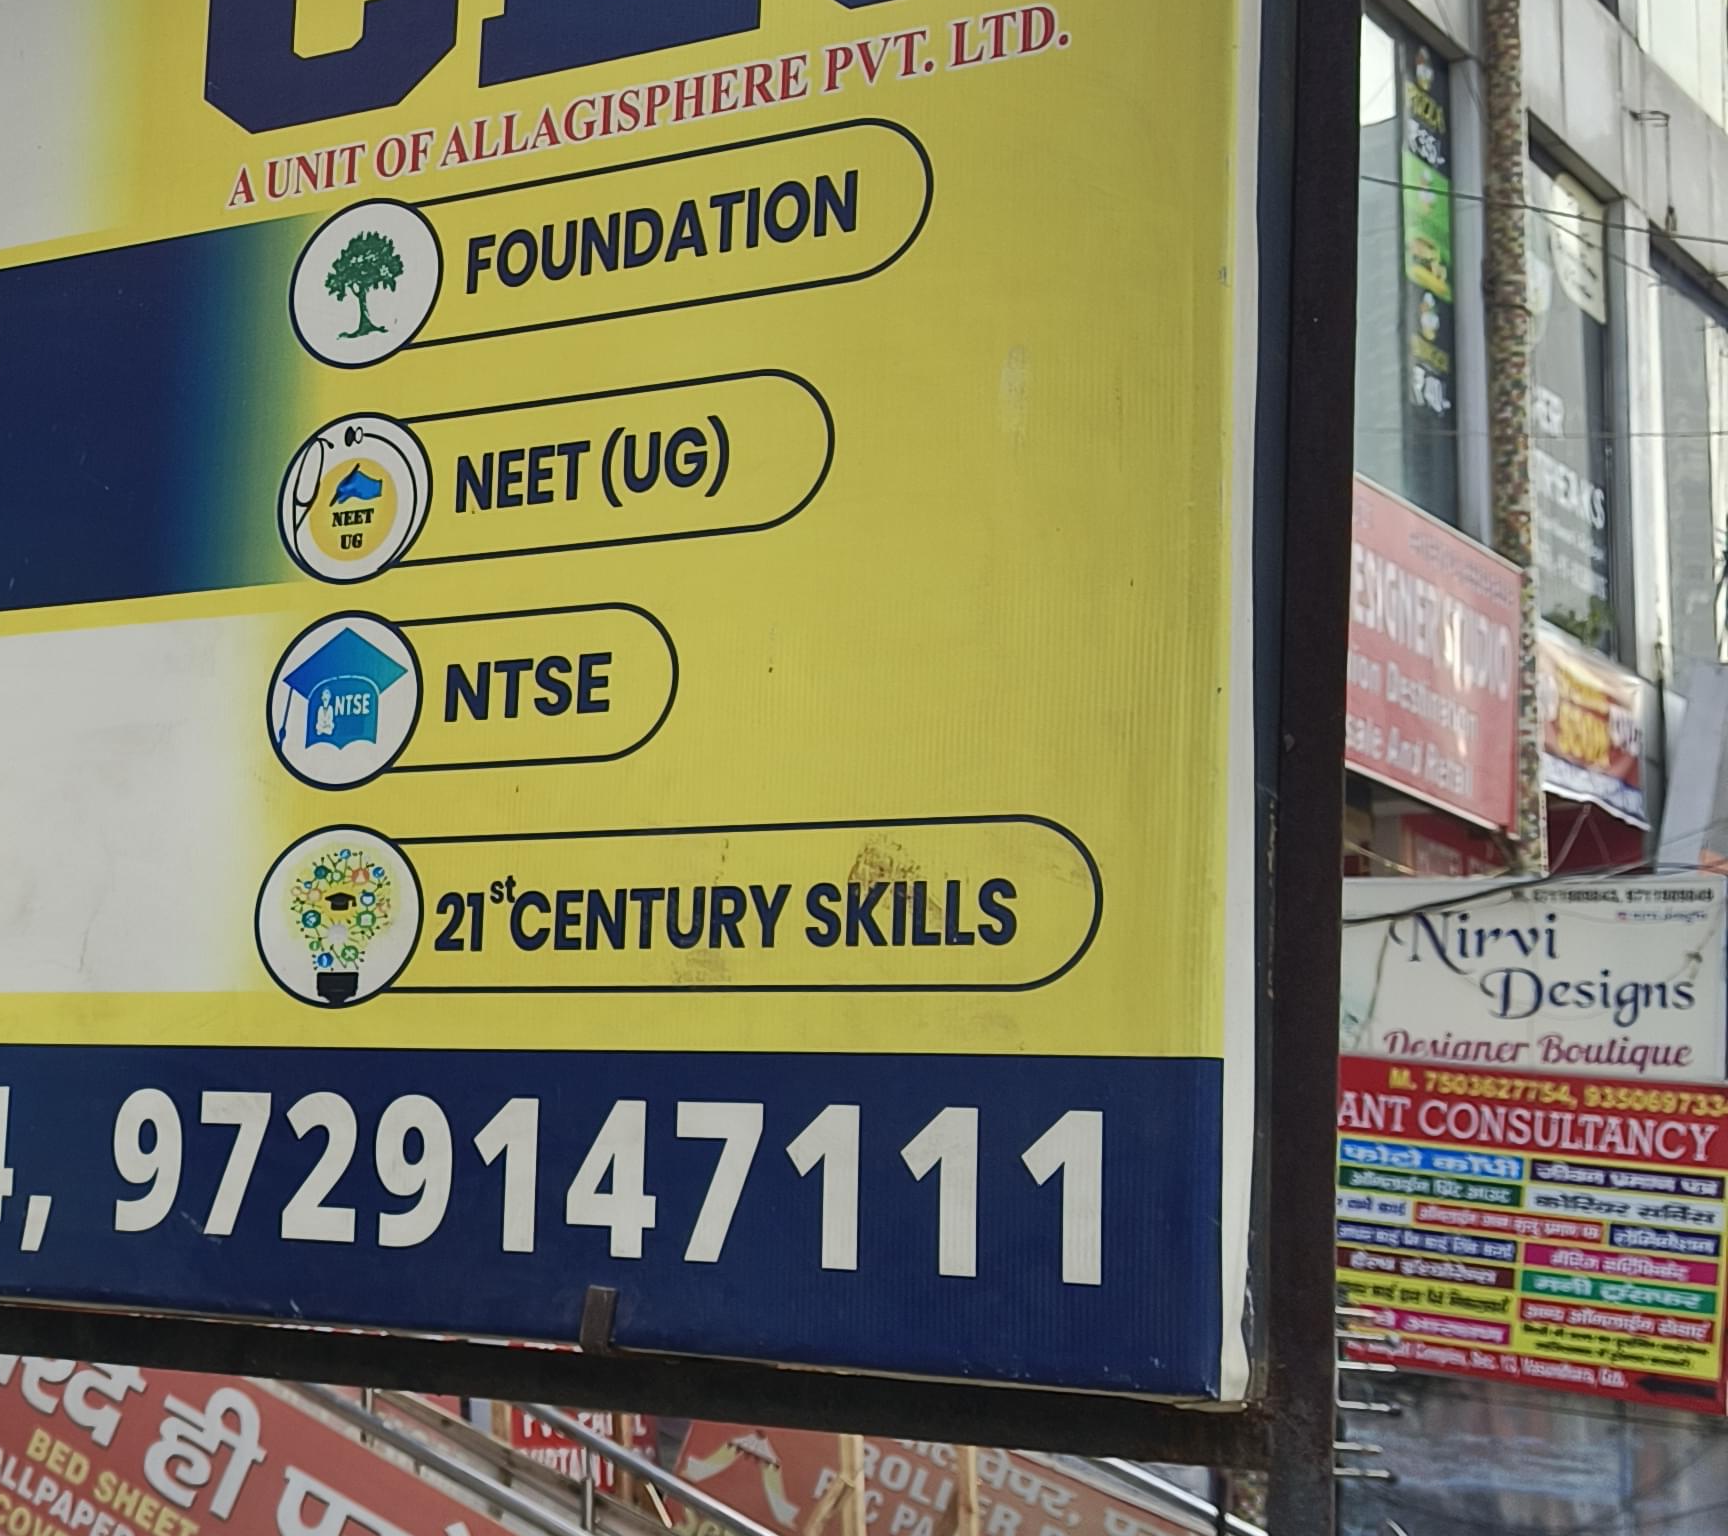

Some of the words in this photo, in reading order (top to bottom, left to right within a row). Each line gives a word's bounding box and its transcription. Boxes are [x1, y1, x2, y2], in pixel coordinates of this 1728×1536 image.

[226, 166, 257, 211] A
[266, 142, 368, 200] UNIT
[373, 127, 436, 185] OF
[437, 52, 811, 172] ALLAGISPHERE
[820, 28, 937, 96] PVT.
[945, 1, 1073, 71] LTD.
[465, 169, 862, 298] FOUNDATION
[453, 440, 593, 515] NEET
[600, 414, 732, 509] (UG)
[331, 507, 375, 529] NEET
[339, 531, 364, 551] UG
[1352, 540, 1440, 670] ESIGNER
[334, 688, 372, 718] NTSE
[442, 650, 615, 725] NTSE
[803, 875, 1020, 950] SKILLS
[1388, 910, 1560, 975] Nirvi
[1479, 968, 1697, 1028] Designs
[1388, 1066, 1418, 1091] M.
[1538, 1032, 1694, 1074] Boutique
[1337, 1091, 1413, 1134] ANT
[1417, 1097, 1720, 1164] CONSULTANCY
[1340, 1138, 1423, 1169] फोटो
[1432, 1151, 1521, 1180] कॉपी
[110, 1086, 1108, 1289] 9729147111
[25, 1427, 92, 1486] BED
[143, 1386, 267, 1523] ही
[813, 1467, 886, 1526] PC
